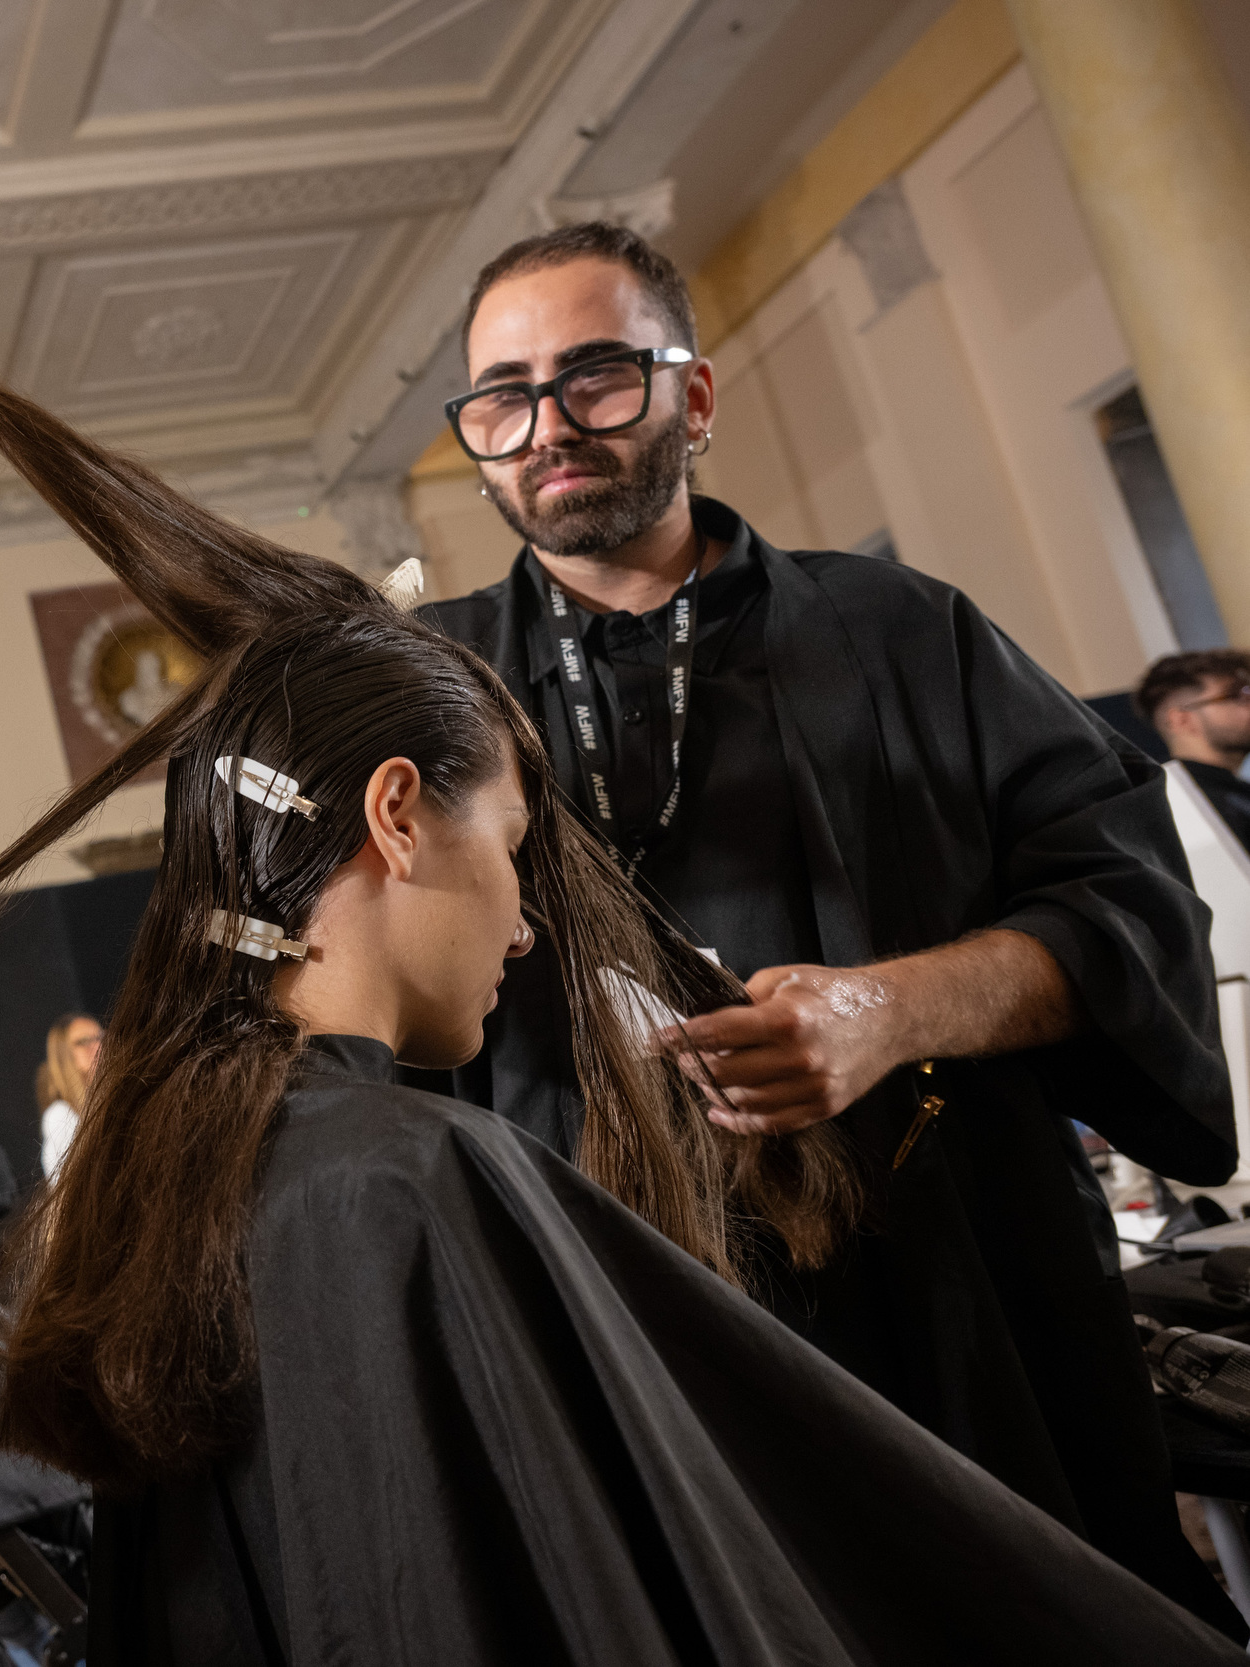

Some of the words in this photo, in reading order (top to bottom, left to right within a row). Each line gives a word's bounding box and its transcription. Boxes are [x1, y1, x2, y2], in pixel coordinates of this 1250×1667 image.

[674, 598, 690, 643] #MFW
[560, 638, 582, 682] #MFW
[672, 666, 685, 714] #MFW
[575, 705, 597, 750] #MFW
[591, 773, 612, 820] #MFW
